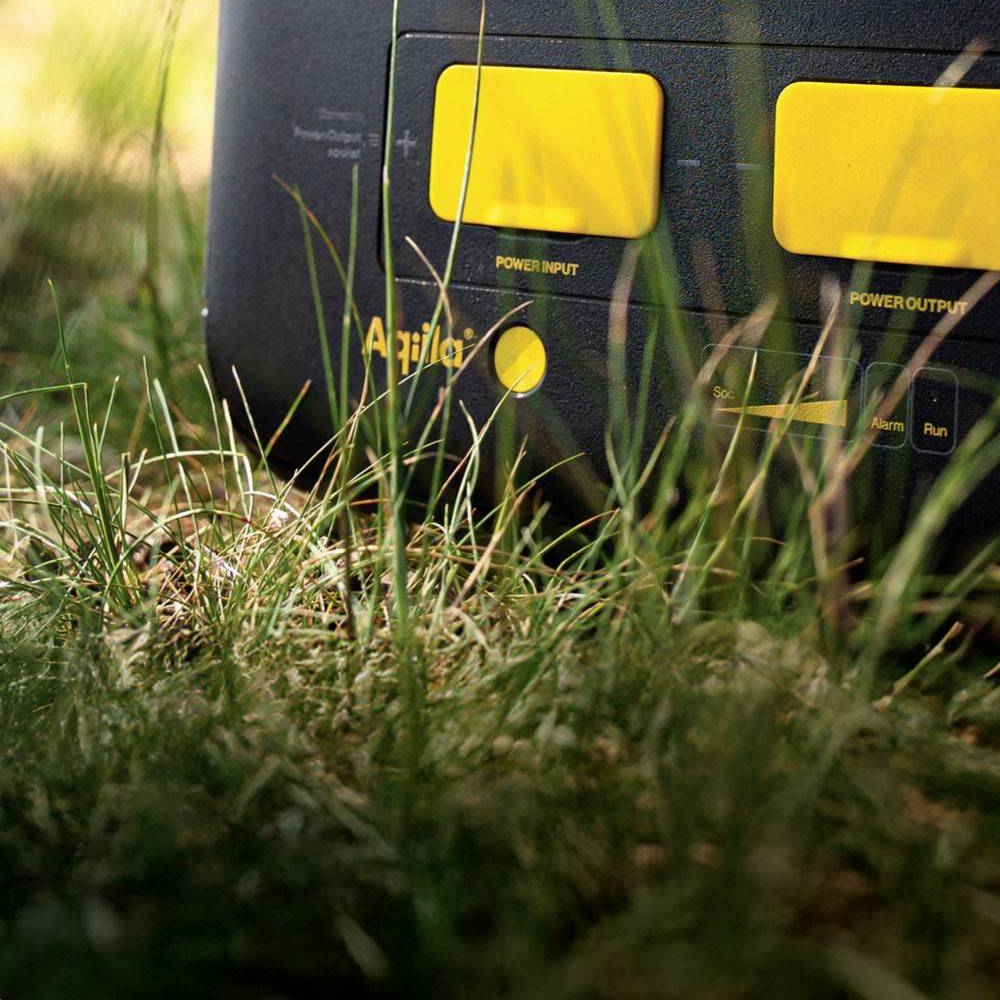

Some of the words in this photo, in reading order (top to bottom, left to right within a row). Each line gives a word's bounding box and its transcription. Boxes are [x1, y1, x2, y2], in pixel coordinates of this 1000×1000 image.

[496, 255, 540, 273] POWER
[542, 260, 580, 276] INPUT
[849, 291, 904, 310] POWER
[905, 296, 968, 315] OUTPUT
[870, 416, 905, 433] Alarm
[923, 422, 948, 438] Run
